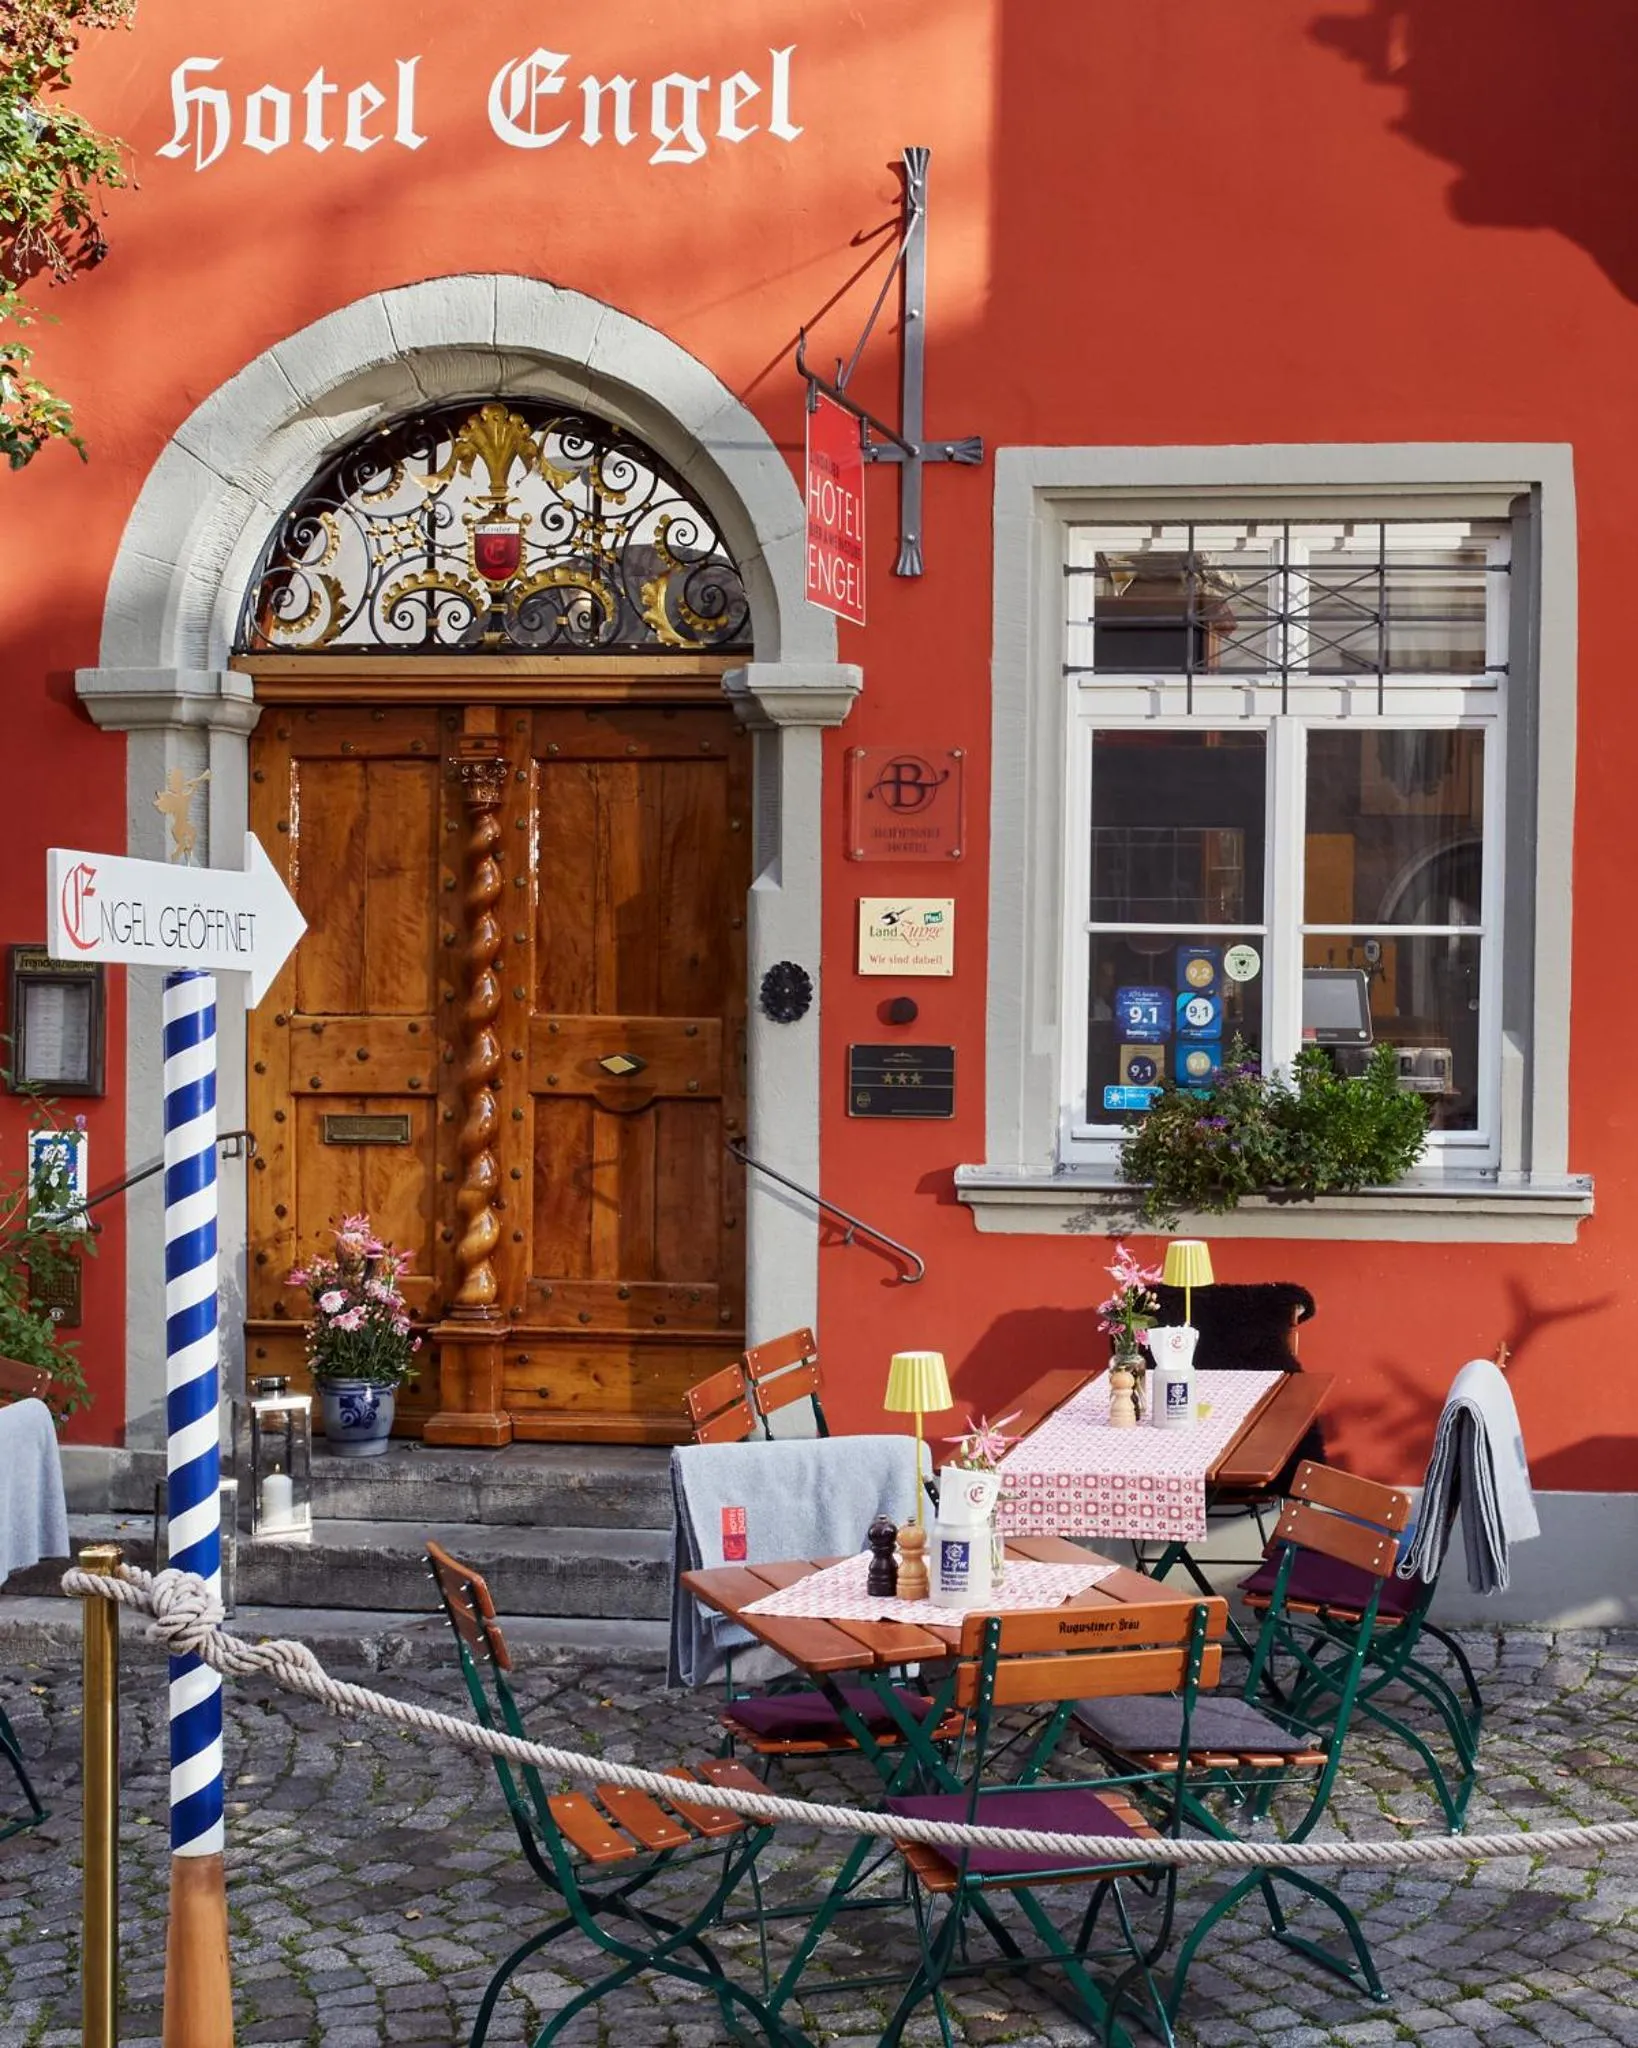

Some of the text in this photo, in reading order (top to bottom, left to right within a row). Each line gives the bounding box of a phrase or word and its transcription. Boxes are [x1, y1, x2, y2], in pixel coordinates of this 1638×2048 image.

[155, 44, 804, 173] Hotel Engel
[808, 471, 862, 542] HOTEL
[808, 543, 862, 610] ENGEL
[62, 862, 257, 953] ENGEL GEÖFFNET
[1129, 1006, 1157, 1024] 9.1
[1189, 1005, 1210, 1019] 9,1
[1130, 1064, 1152, 1079] 9,1
[1059, 1618, 1115, 1636] Augustiner
